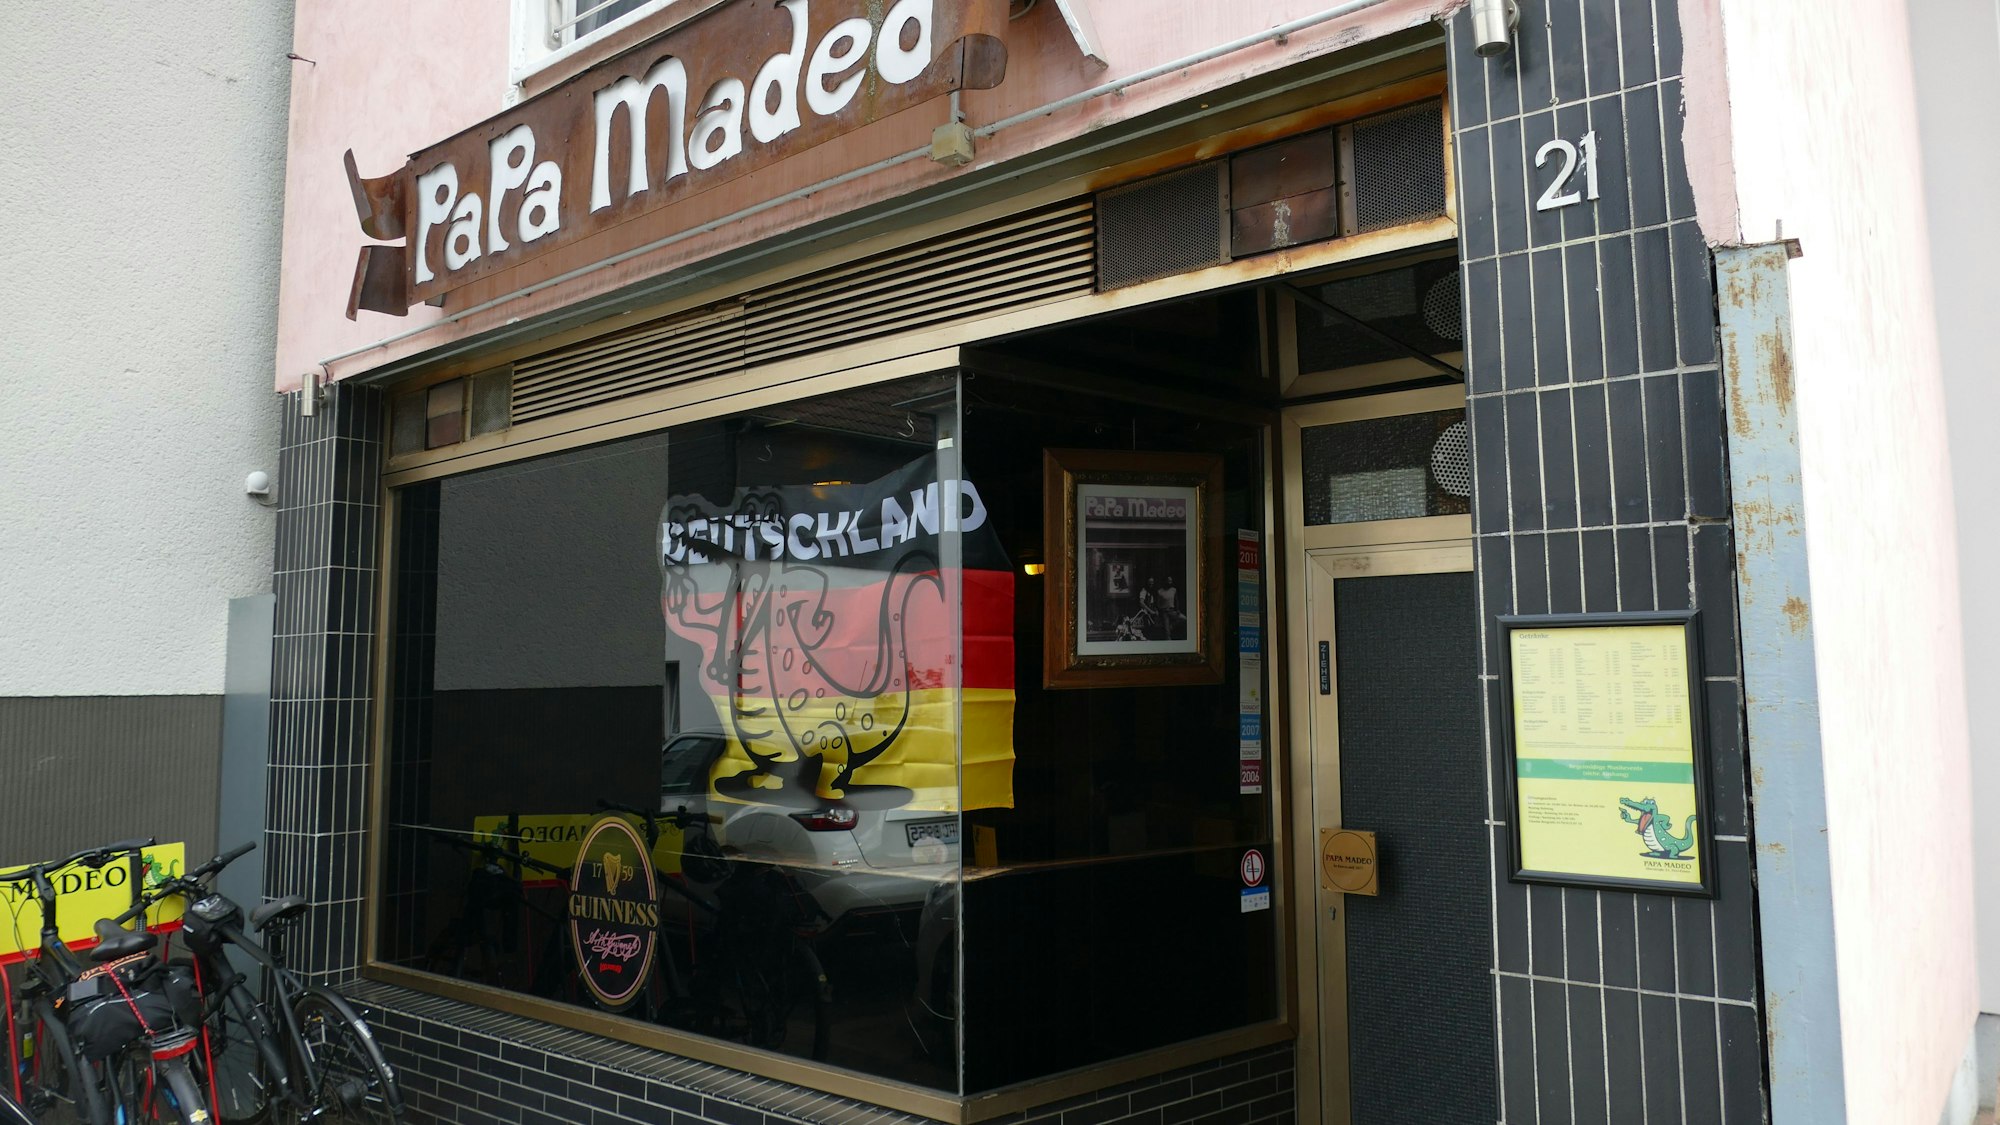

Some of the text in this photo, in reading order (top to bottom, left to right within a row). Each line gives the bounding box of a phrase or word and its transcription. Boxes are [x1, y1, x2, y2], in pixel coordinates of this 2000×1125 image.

[1535, 130, 1600, 211] 21
[662, 479, 987, 566] DEUTSCHLAND
[1240, 552, 1258, 564] 2011
[1241, 637, 1259, 648] 2009
[1320, 644, 1328, 691] ZIEHEN
[1241, 725, 1260, 736] 2007
[1241, 771, 1260, 783] 2006
[1326, 854, 1373, 865] PAPA MADEO
[1664, 861, 1692, 870] MADEO
[9, 866, 127, 902] MDEO
[569, 894, 659, 928] GUINNESS
